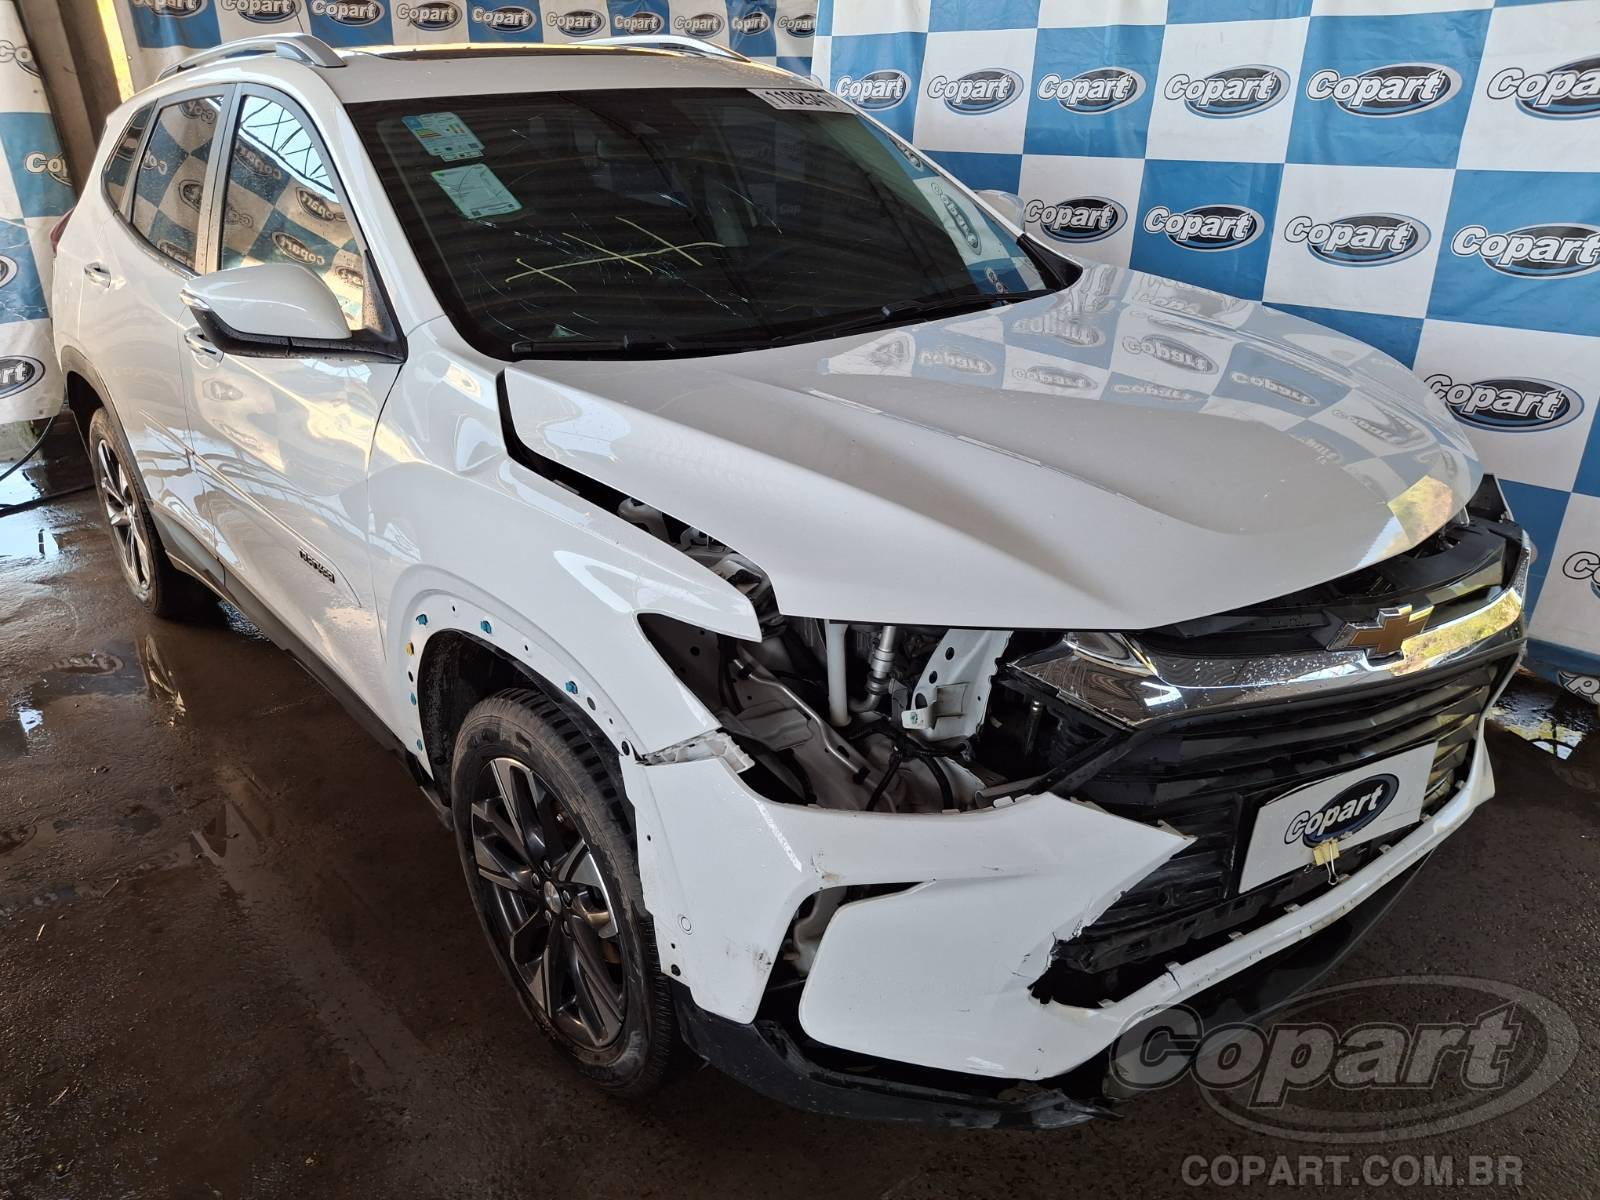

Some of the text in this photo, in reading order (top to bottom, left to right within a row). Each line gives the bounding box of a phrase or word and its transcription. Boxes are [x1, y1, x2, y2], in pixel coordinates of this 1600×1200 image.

[311, 0, 378, 20] Copart
[397, 3, 456, 23] Copart
[472, 6, 529, 27] Copart
[546, 12, 599, 28] Copart
[614, 15, 657, 31] Copart
[674, 15, 719, 31] Copart
[731, 17, 765, 31] Copart
[835, 71, 904, 102] Copart
[926, 74, 1011, 103] Copart
[1037, 72, 1133, 106] Copart
[1164, 70, 1276, 107] Copart
[1306, 67, 1445, 107] Copart
[1487, 67, 1600, 108] Copa
[1025, 199, 1116, 231] Copart
[1144, 205, 1253, 243] Copart
[1284, 216, 1414, 254] Copart
[1451, 224, 1600, 267] Copart
[1423, 374, 1565, 420] Copart
[1284, 783, 1384, 845] Copart
